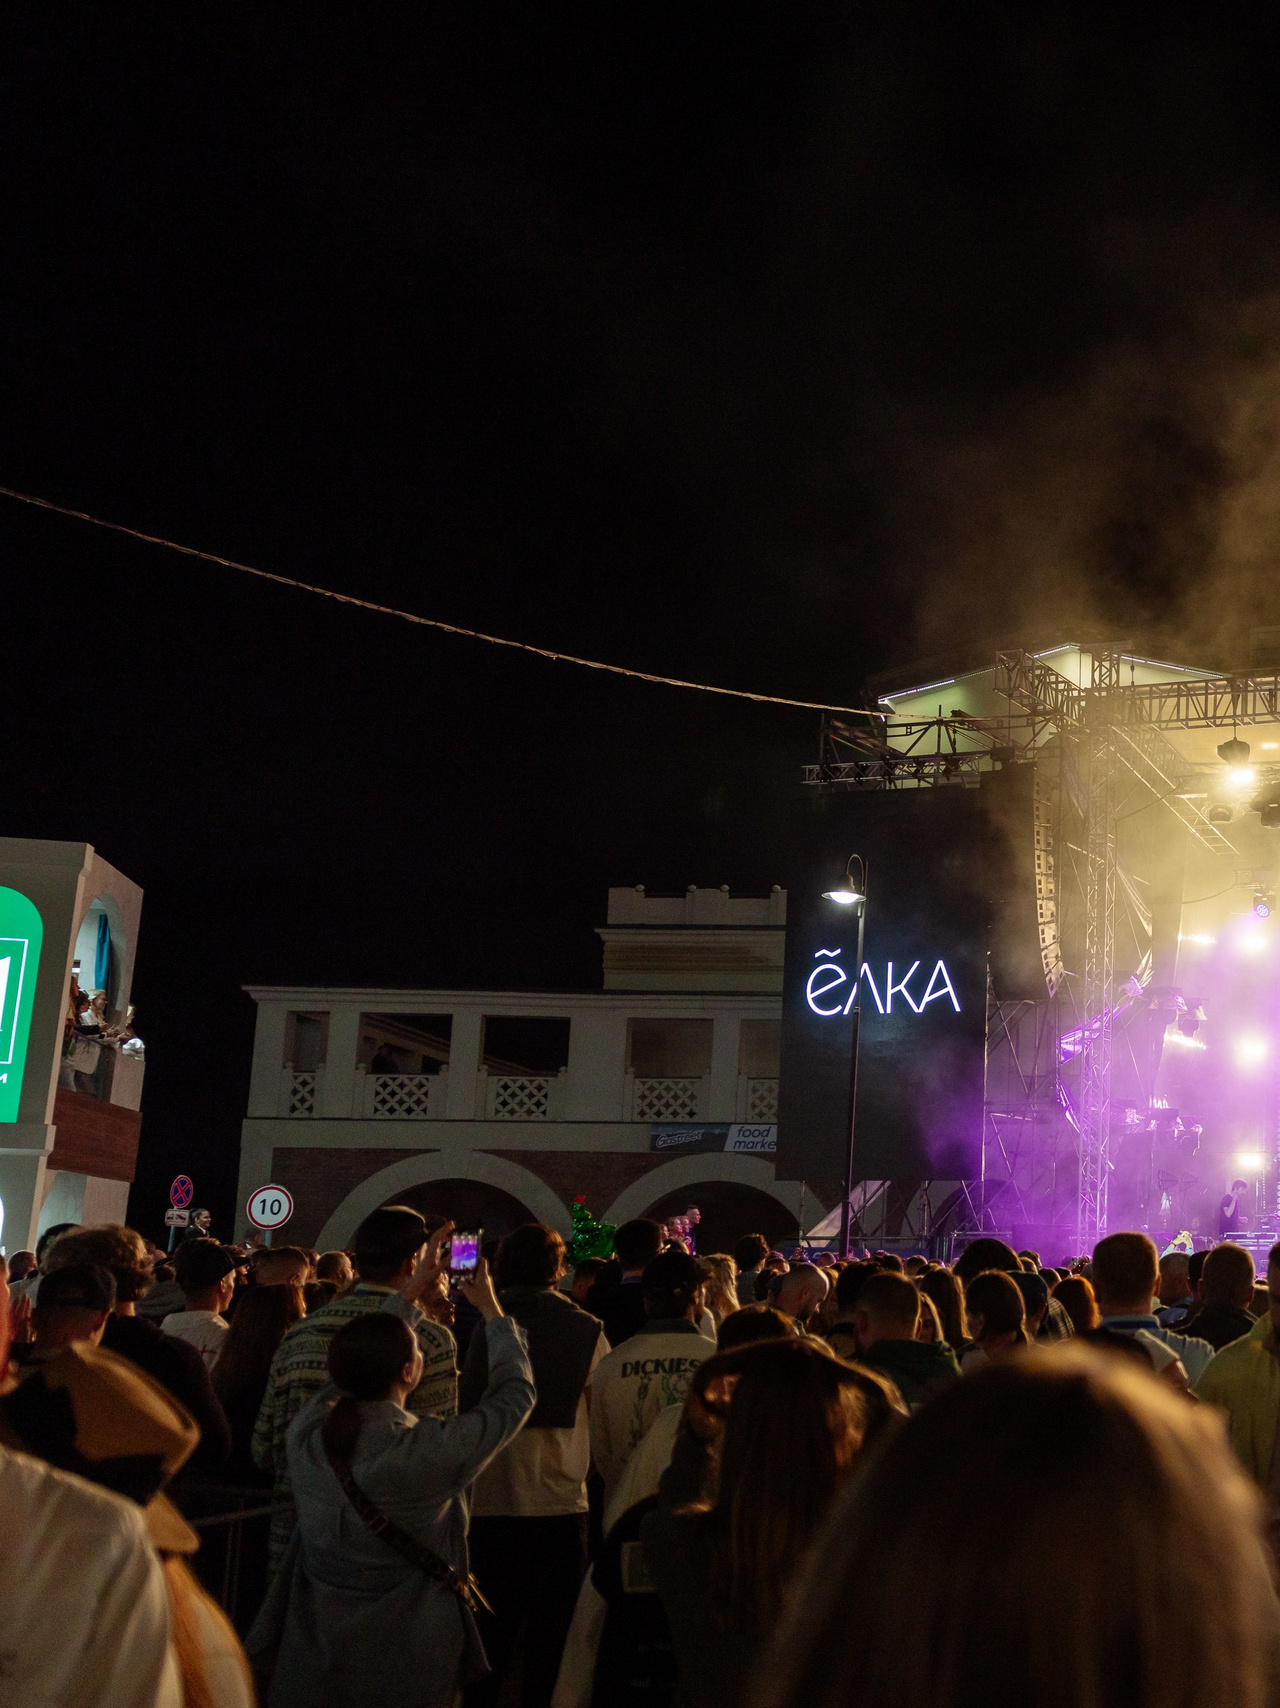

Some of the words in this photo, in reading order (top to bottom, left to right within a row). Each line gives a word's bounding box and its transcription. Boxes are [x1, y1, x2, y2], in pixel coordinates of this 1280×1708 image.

[656, 1129, 703, 1148] Gastreet
[736, 1125, 771, 1138] food
[732, 1138, 777, 1150] marke
[259, 1198, 282, 1216] 10
[621, 1357, 701, 1378] DICKIES
